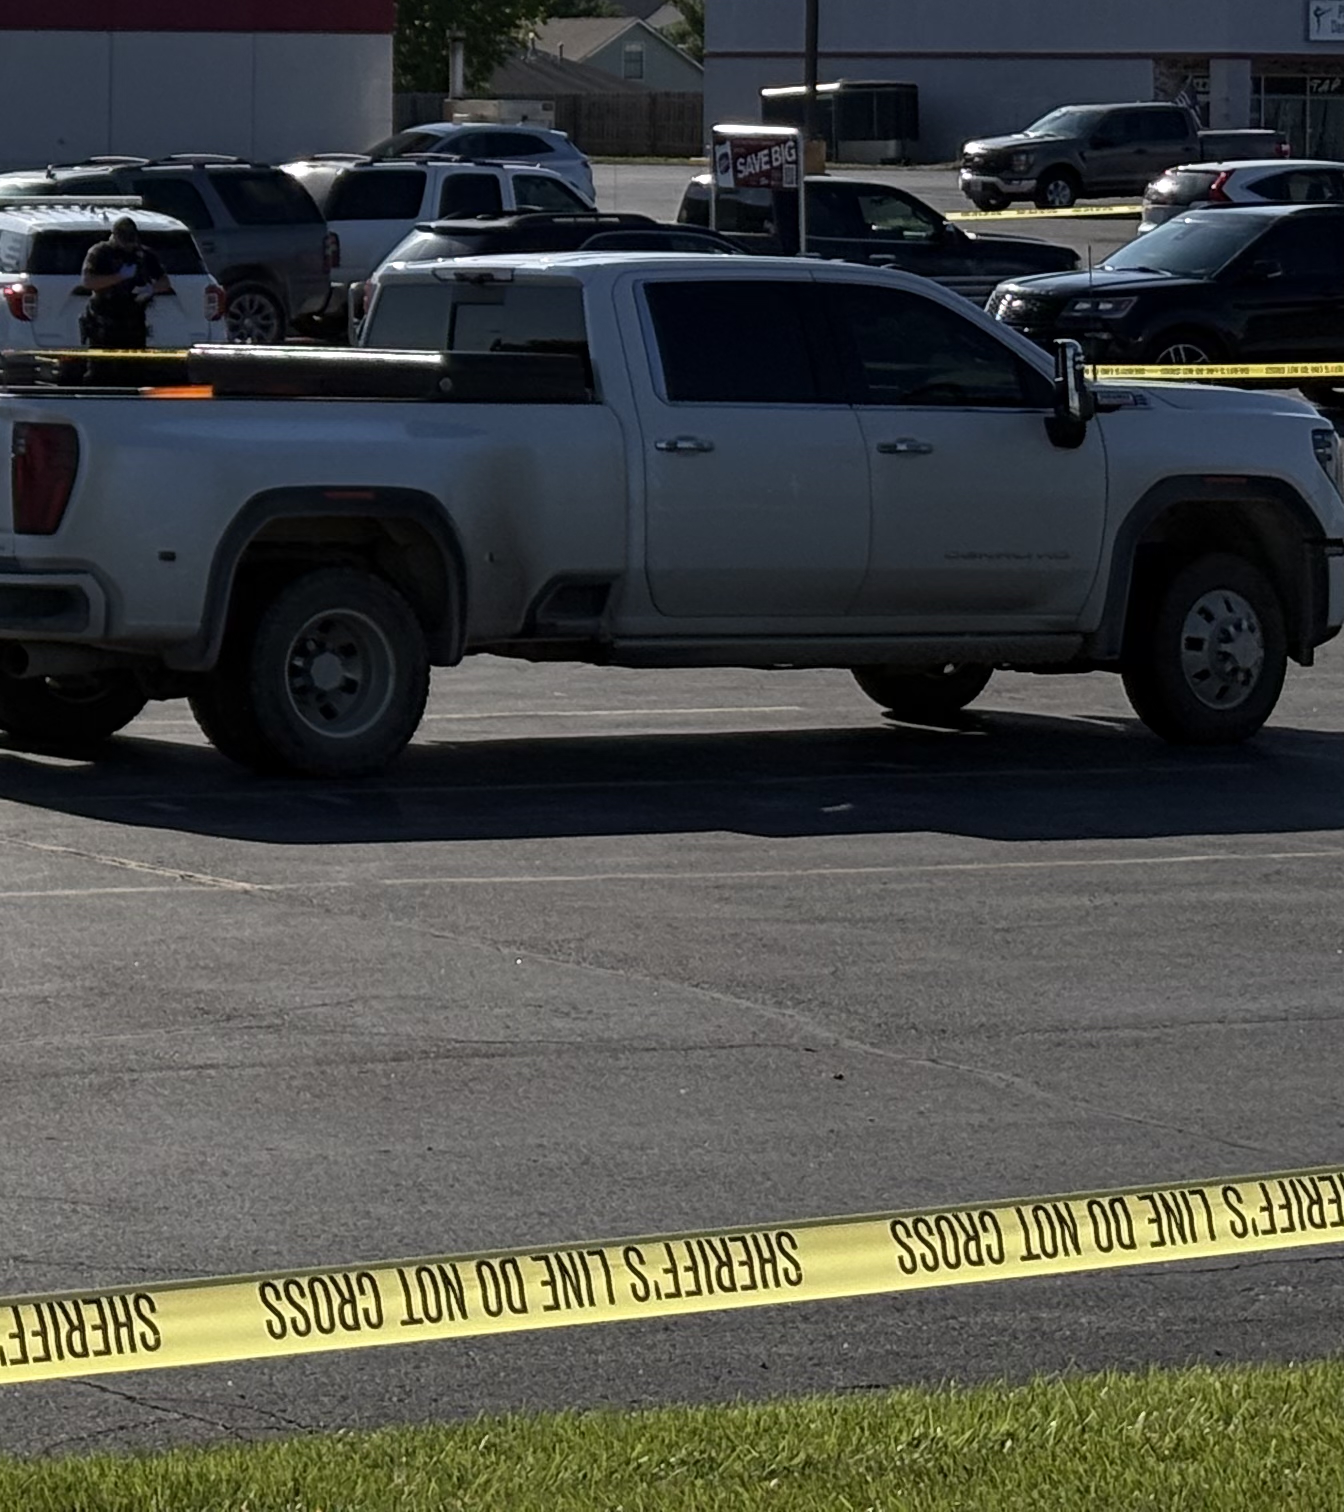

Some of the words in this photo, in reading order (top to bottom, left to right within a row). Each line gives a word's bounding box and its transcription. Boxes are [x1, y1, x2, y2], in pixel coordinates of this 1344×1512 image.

[736, 147, 771, 178] SAVE
[770, 138, 797, 168] BIG
[1016, 1203, 1080, 1260] NOT
[1087, 1198, 1136, 1252] DO
[1138, 1191, 1215, 1246] LINE
[1222, 1180, 1344, 1238] ERIFF'S
[624, 1232, 802, 1301] SHERIFF'S
[891, 1211, 1004, 1273] CROSS
[259, 1272, 383, 1339] CROSS
[397, 1264, 467, 1325] NOT
[476, 1257, 527, 1316] DO
[531, 1249, 614, 1310] LINE
